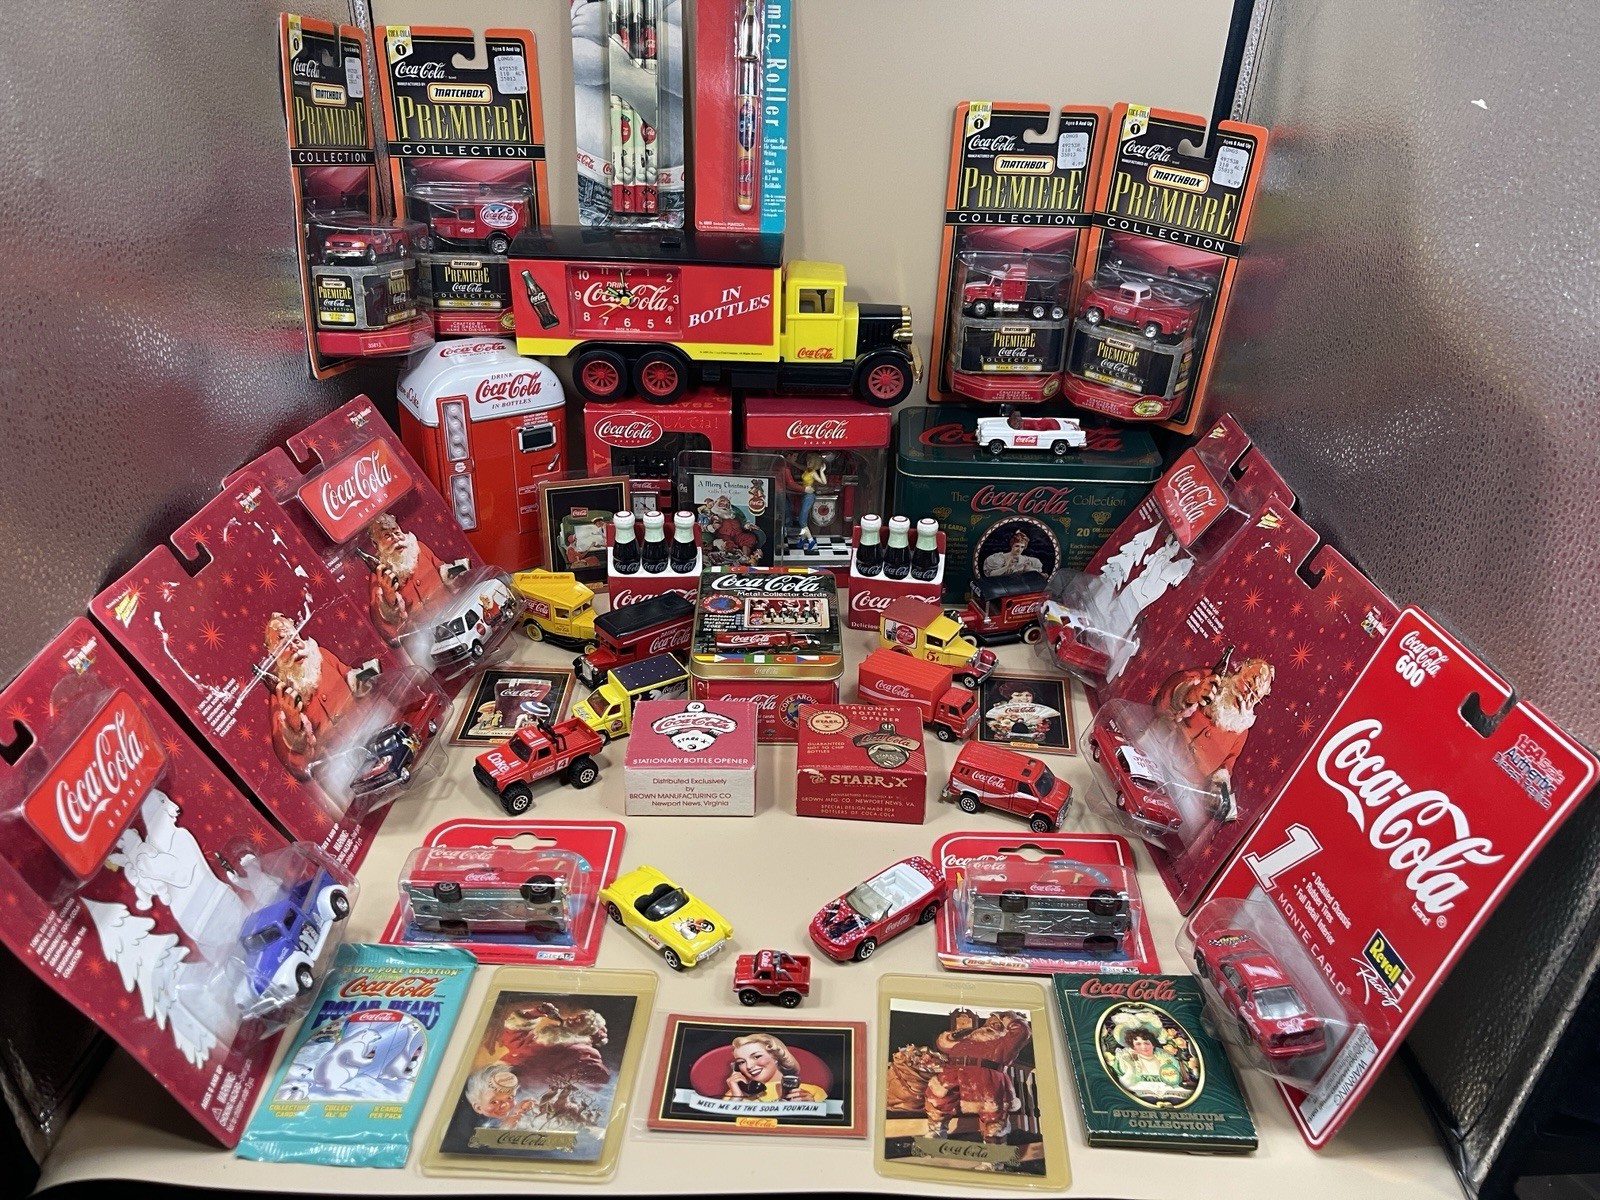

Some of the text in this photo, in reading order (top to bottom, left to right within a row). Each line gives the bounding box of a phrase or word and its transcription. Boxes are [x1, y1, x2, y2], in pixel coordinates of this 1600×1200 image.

[398, 45, 405, 55] 1
[394, 61, 446, 79] Coca-Cola
[314, 88, 343, 101] MATCHBOX
[434, 88, 485, 98] MATCHBOX
[765, 57, 788, 127] Roller
[295, 97, 366, 146] PREMIERE
[397, 96, 527, 141] PREMIERE
[976, 118, 982, 128] 1
[1132, 124, 1139, 134] 1
[402, 145, 527, 157] COLLECTION
[968, 135, 1017, 152] Coca-Cola
[1123, 139, 1173, 163] Coca-Cola
[299, 151, 367, 163] COLLECTION
[999, 159, 1049, 170] MATCHBOX
[1152, 170, 1204, 187] MATCHBOX
[961, 167, 1083, 210] PREMIERE
[1110, 171, 1236, 236] PREMIERE
[958, 213, 1077, 226] COLLECTION
[1107, 217, 1225, 252] COLLECTION
[444, 266, 490, 283] PREMIERE
[577, 270, 589, 280] 10
[666, 273, 673, 283] 2
[318, 286, 352, 299] PREMIERE
[452, 282, 483, 293] Coca-Cola
[606, 281, 629, 289] DRINK
[574, 290, 582, 300] 9
[672, 294, 680, 304] 3
[721, 286, 742, 303] IN
[583, 311, 591, 322] 8
[688, 294, 771, 328] BOTTLES
[602, 316, 609, 326] 7
[624, 317, 631, 328] 6
[647, 318, 654, 329] 5
[665, 315, 672, 326] 4
[993, 332, 1037, 348] PREMIERE
[440, 342, 506, 358] Coca-Cola
[797, 347, 834, 360] Coca-Cola
[998, 347, 1028, 357] Coca-Cola
[1097, 341, 1140, 367] PREMIERE
[1083, 362, 1144, 384] COLLECTION
[1100, 358, 1130, 373] Coca-Cola
[475, 370, 542, 404] Coca-Cola
[501, 399, 532, 409] BOTTLES
[599, 421, 653, 440] Coca-Cola
[786, 420, 849, 440] Coca-Cola
[1015, 435, 1037, 445] Coca-Cola
[322, 449, 392, 521] Coca-Cola
[705, 479, 723, 490] Merry
[723, 480, 750, 490] Christmas
[951, 484, 1126, 515] The Coca-Cola Collection
[1168, 465, 1216, 523] Coca-Cola
[358, 493, 389, 519] BRAND
[949, 524, 967, 533] CARDS
[1076, 527, 1090, 537] 20
[711, 573, 825, 592] Coca-Cola
[650, 628, 692, 654] Coca-Cola
[660, 629, 677, 637] DRINK
[731, 634, 770, 644] Coca-Cola
[1398, 630, 1449, 679] Coca-Cola
[1396, 656, 1427, 689] 600
[500, 688, 544, 698] Coca-Cola
[875, 680, 911, 698] Coca-Cola
[780, 696, 795, 712] COKE
[1005, 706, 1036, 714] Coca-Cola
[656, 717, 732, 731] Coca-Cola
[782, 715, 794, 727] THE
[861, 734, 911, 747] Coca-Cola
[487, 752, 510, 773] Coke
[56, 708, 144, 842] Coca-Cola
[971, 770, 1006, 789] Coca-Cola
[1503, 746, 1557, 797] Authentic
[830, 775, 894, 788] STARR
[892, 776, 912, 788] "X"
[107, 778, 142, 828] BRAND
[1317, 719, 1504, 915] Coca-Cola
[428, 844, 498, 861] Coca-Cola
[1242, 822, 1324, 891] 1
[465, 873, 500, 882] Coca-Cola
[1030, 884, 1066, 893] Coca-Cola
[1305, 881, 1334, 924] Rubber Tires
[1313, 875, 1352, 930] Detailed Chassis
[1295, 887, 1336, 946] Full Detail Interior
[1411, 901, 1431, 926] brand
[885, 913, 911, 933] Coca-Cola
[1278, 892, 1312, 945] MONTE
[1310, 943, 1346, 996] CARLO
[761, 951, 772, 968] Coke
[1369, 936, 1402, 983] Revell
[378, 966, 458, 976] POLE VACATION
[339, 976, 446, 998] Coca-Cola
[1079, 977, 1178, 1001] Coca-Cola
[1351, 957, 1402, 1013] Racing
[359, 1013, 393, 1022] Coca-Cola
[1333, 1059, 1368, 1106] WARNING
[697, 1099, 716, 1108] MEET
[737, 1117, 776, 1127] Coca-Cola
[1112, 1108, 1226, 1122] SUPER PREMIUM
[1127, 1119, 1215, 1131] COLLECTION
[497, 1131, 548, 1146] Coca-Cola
[938, 1139, 989, 1160] Coca-Cola
